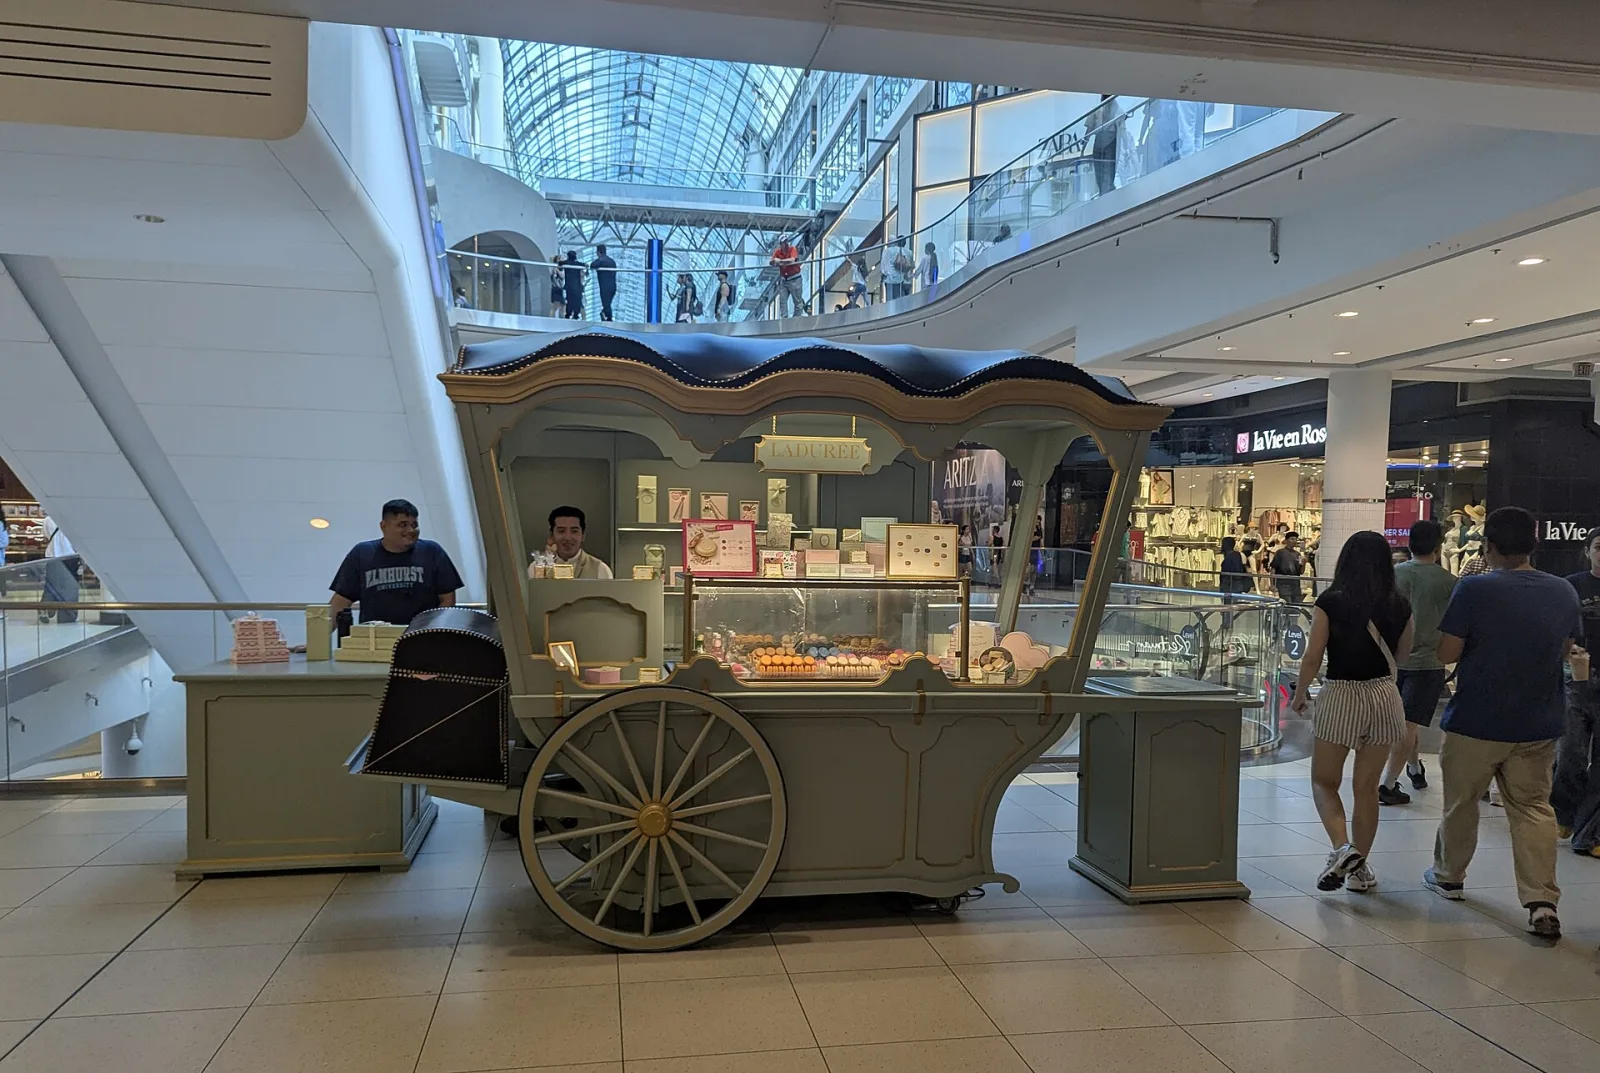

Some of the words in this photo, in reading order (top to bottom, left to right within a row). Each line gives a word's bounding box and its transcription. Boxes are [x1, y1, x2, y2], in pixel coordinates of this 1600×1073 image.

[1037, 131, 1082, 159] ZARA
[1577, 364, 1591, 376] EXIT
[770, 442, 861, 460] LADURÉE
[365, 565, 424, 589] ELMHURST
[376, 582, 414, 591] UNIVERSITY
[1288, 630, 1302, 639] Level
[1290, 639, 1299, 656] 2
